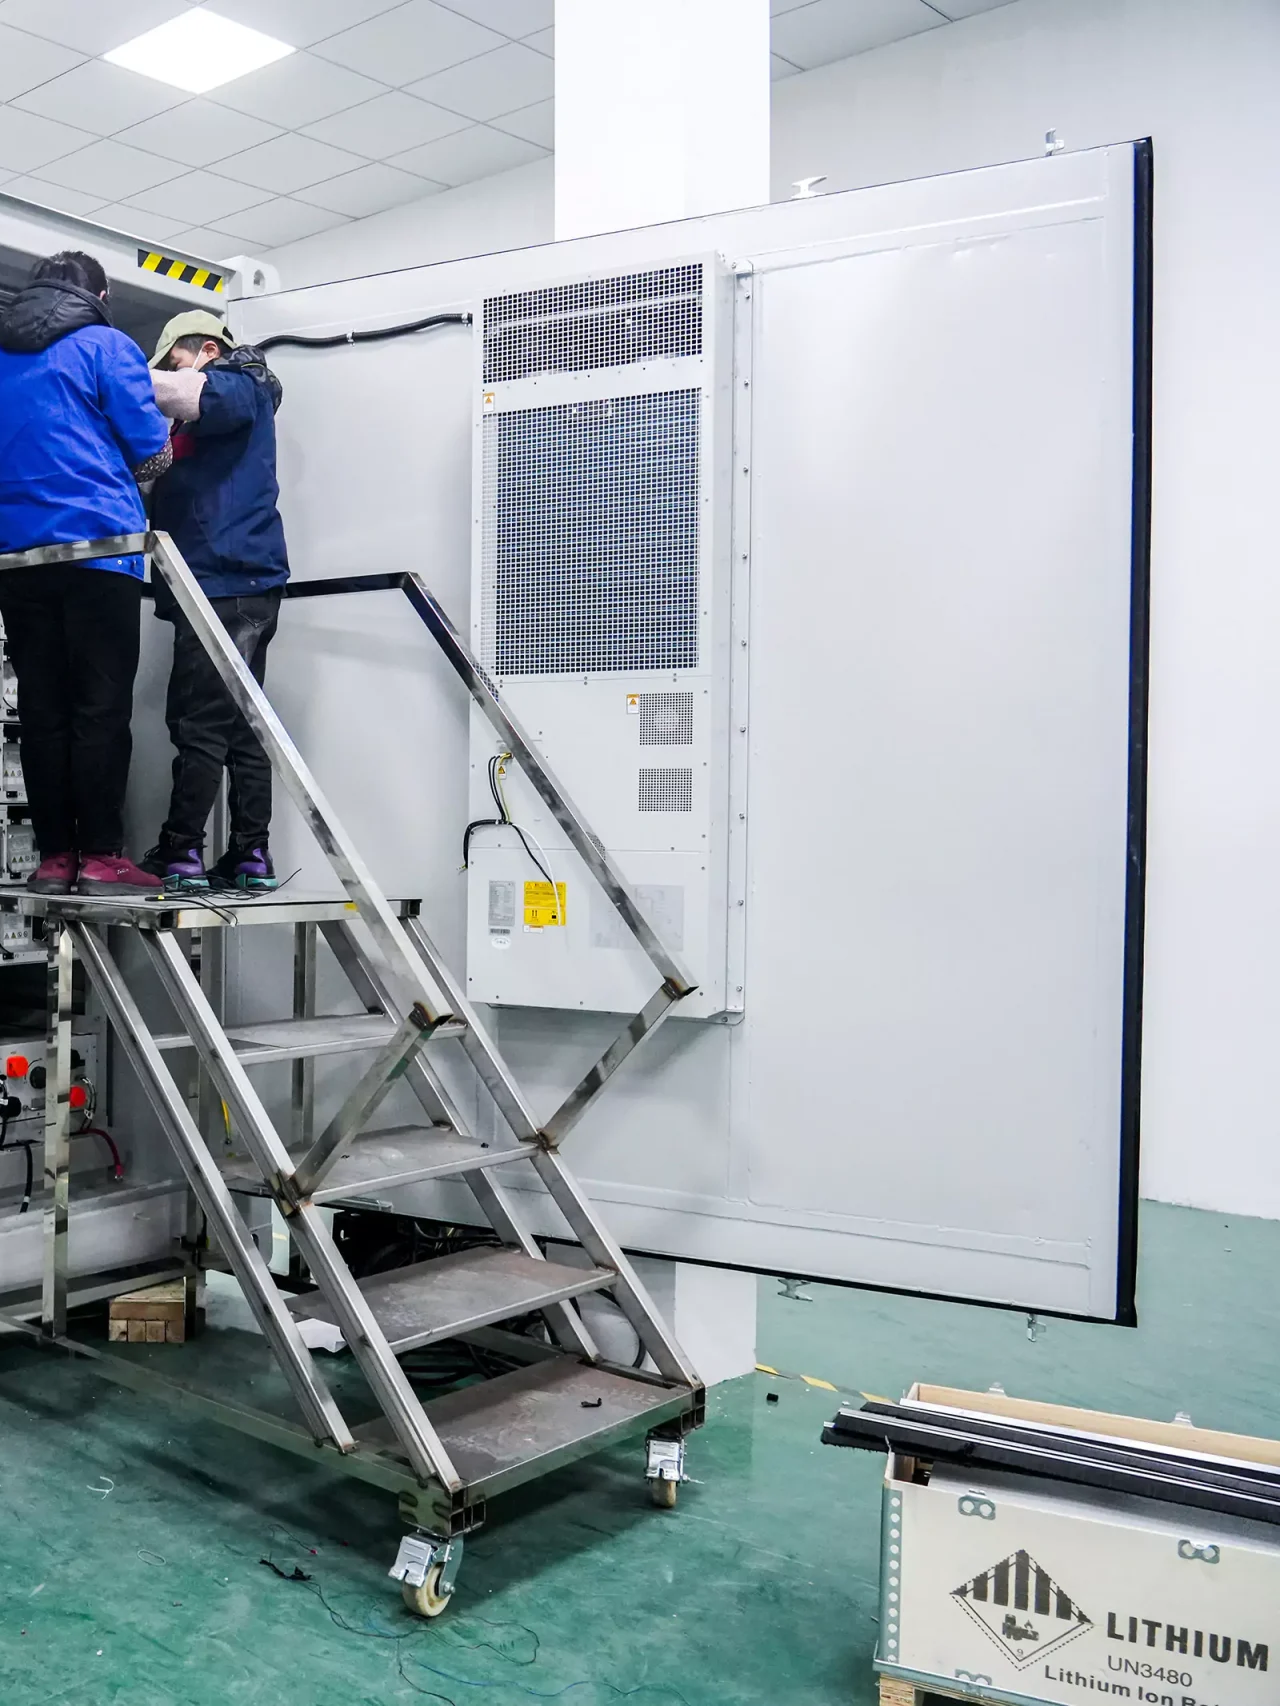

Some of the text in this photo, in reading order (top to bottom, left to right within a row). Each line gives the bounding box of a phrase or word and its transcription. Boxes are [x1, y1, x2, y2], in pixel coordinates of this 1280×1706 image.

[1108, 1612, 1269, 1672] LITHIUM
[1044, 1664, 1173, 1706] Lithium Ion
[1108, 1655, 1193, 1687] UN3480
